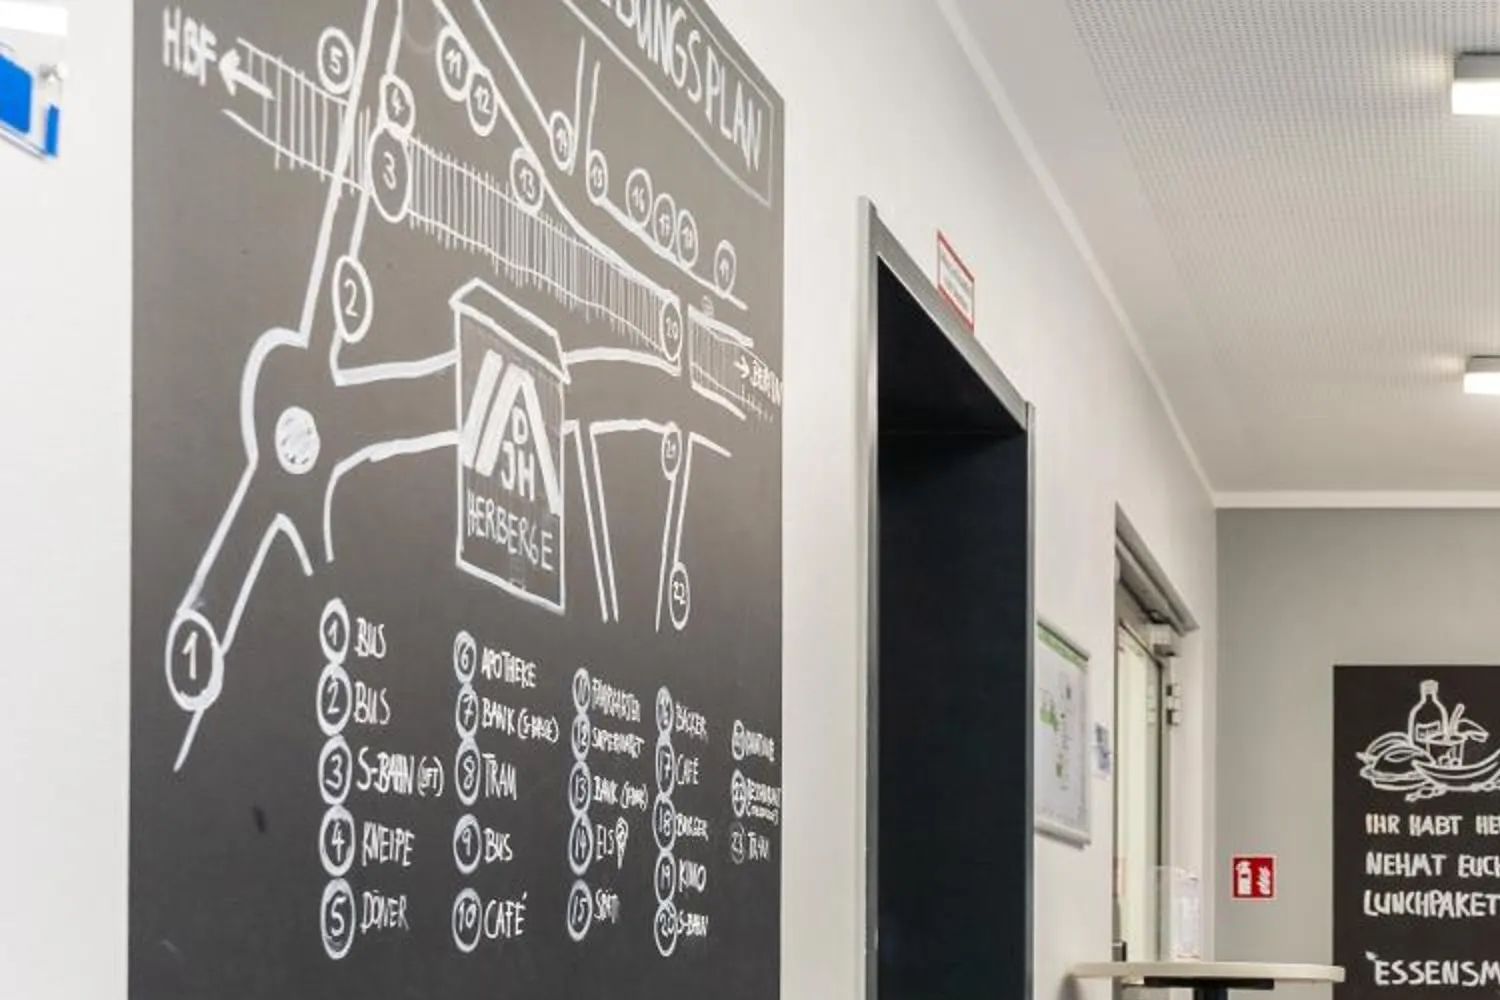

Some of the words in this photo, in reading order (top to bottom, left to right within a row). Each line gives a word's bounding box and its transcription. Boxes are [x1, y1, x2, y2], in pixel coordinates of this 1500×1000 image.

[163, 5, 217, 86] HBF
[512, 405, 529, 445] D
[501, 440, 535, 502] JH
[466, 487, 555, 572] HERBERGE
[354, 617, 387, 658] BUS
[481, 646, 537, 689] APOTHEKE
[354, 681, 391, 725] BUS
[481, 697, 516, 736] BANK
[356, 745, 415, 795] S-BAHN
[481, 753, 518, 801] TRAM
[361, 821, 416, 867] KNEIPE
[483, 827, 513, 864] BUS
[596, 824, 615, 861] EIS
[1365, 813, 1400, 836] IHR
[1409, 814, 1463, 837] HABT
[1365, 852, 1447, 878] NEHMT
[484, 891, 528, 939] CAFÉ
